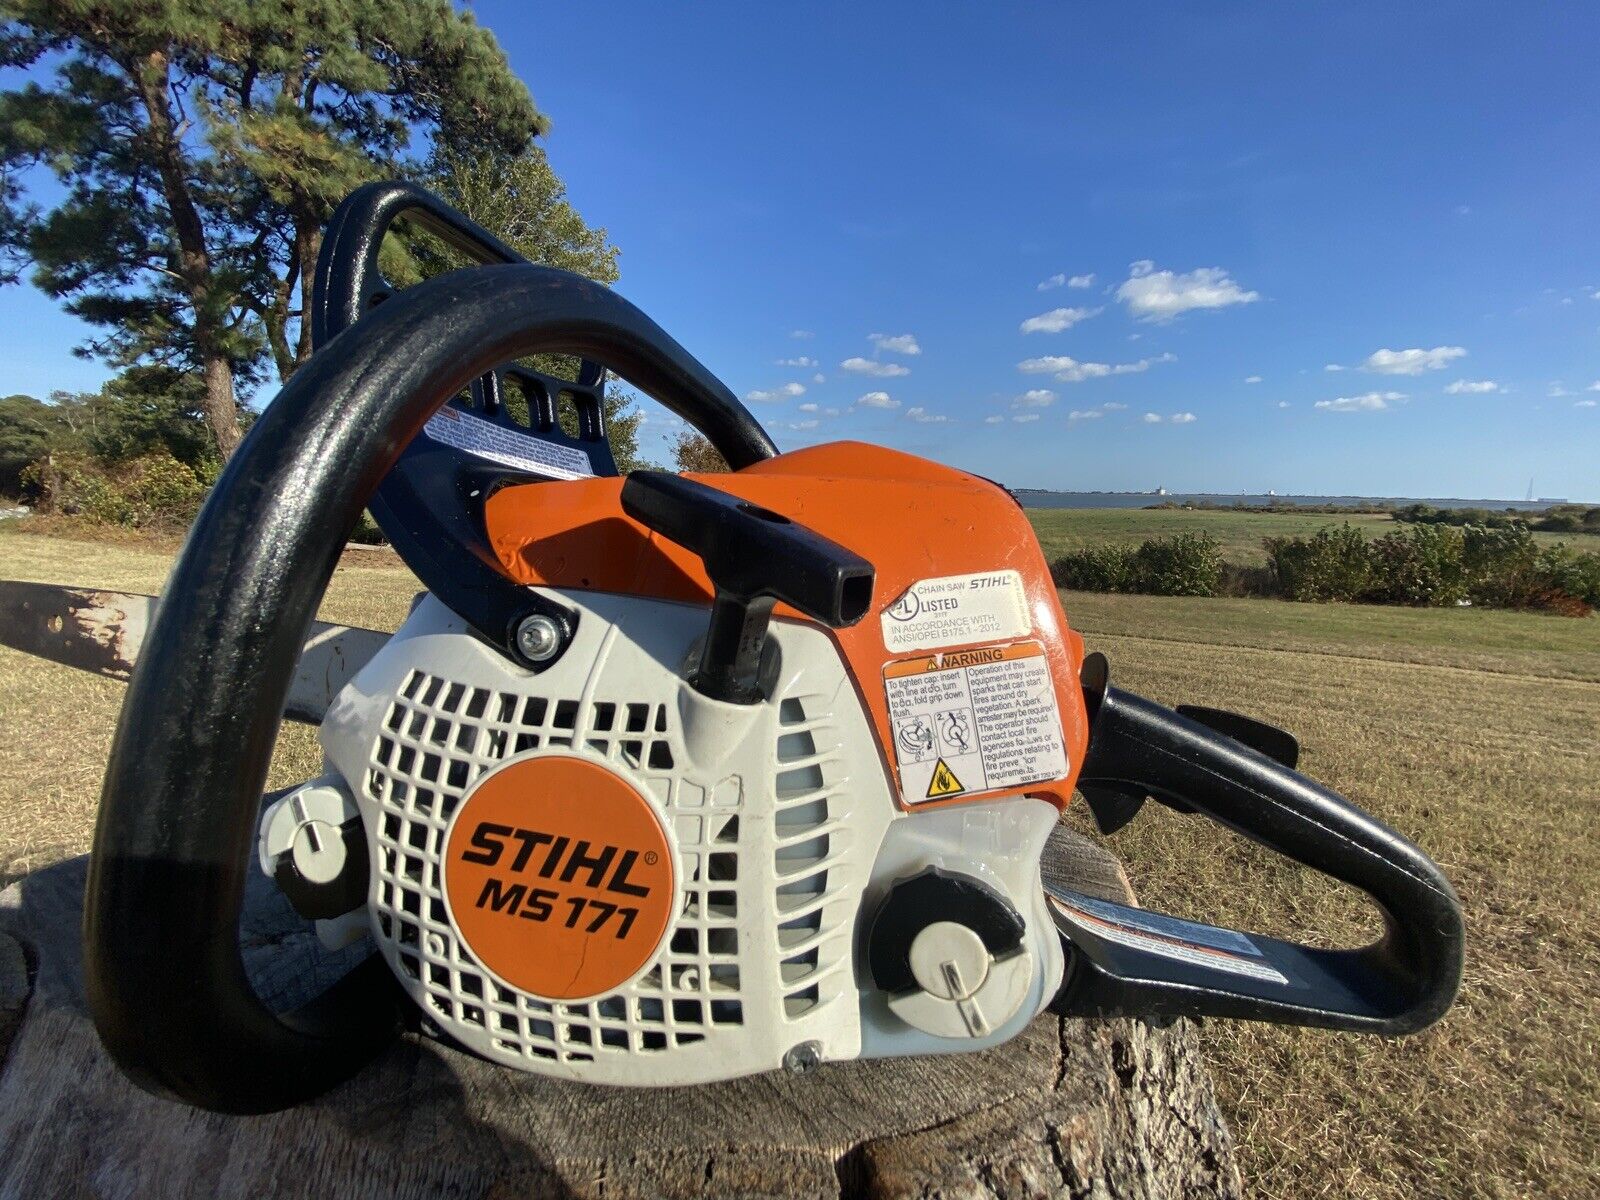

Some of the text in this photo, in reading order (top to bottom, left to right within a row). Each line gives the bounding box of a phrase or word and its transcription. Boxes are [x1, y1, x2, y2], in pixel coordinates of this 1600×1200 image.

[918, 584, 945, 595] CHAIN
[947, 582, 966, 591] SAW
[921, 598, 959, 612] LISTED
[892, 614, 996, 635] IN ACCORDANCE WITH
[893, 630, 941, 644] ANSI/OPEI
[979, 622, 1001, 633] 2012
[969, 661, 1025, 677] Operation of this
[888, 681, 898, 689] To
[898, 677, 923, 689] tighten
[941, 671, 961, 681] insert
[971, 668, 1046, 688] equipment may create
[890, 689, 905, 699] with
[906, 687, 919, 696] line
[943, 682, 957, 691] turn
[972, 678, 1042, 696] sparks that can start
[891, 691, 964, 709] to fold grip down
[973, 689, 1028, 704] fires around dry
[1015, 700, 1021, 708] A
[1022, 696, 1042, 707] spark
[937, 713, 944, 721] 2.
[1003, 711, 1018, 721] may
[1018, 708, 1027, 716] be
[979, 715, 1049, 732] The operator should
[981, 727, 1038, 743] contact local fire
[983, 740, 1015, 753] agencies
[1044, 734, 1052, 742] or
[984, 742, 1059, 762] regulations relating to
[986, 762, 998, 771] fire
[475, 878, 640, 940] MS 171
